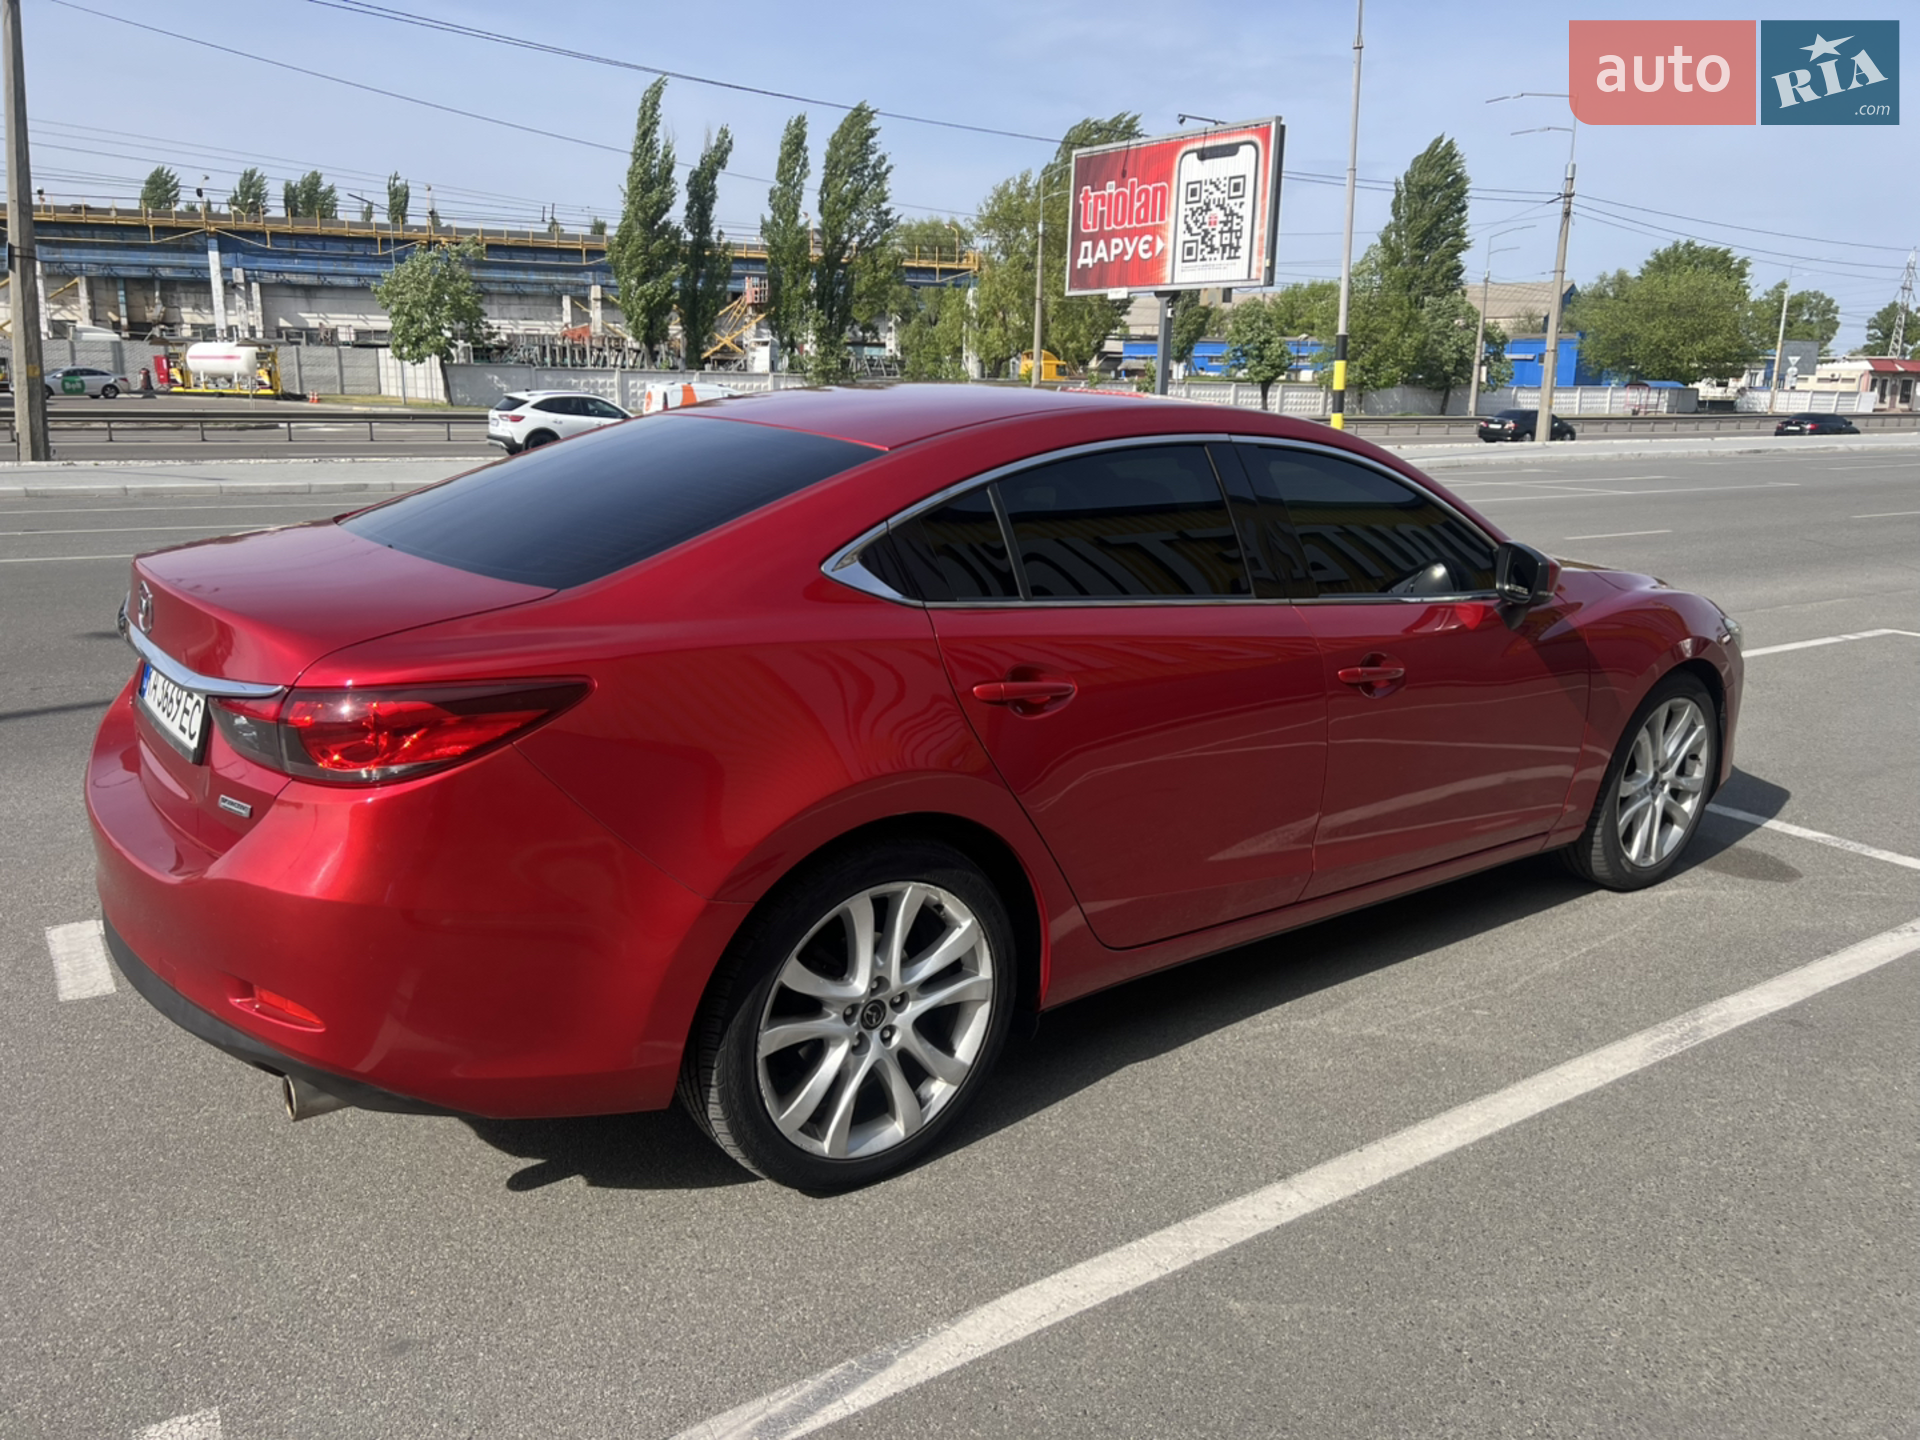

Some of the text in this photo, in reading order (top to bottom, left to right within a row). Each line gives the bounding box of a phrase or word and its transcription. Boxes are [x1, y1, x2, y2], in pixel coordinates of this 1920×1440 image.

[1079, 177, 1169, 233] triolan
[1077, 234, 1154, 269] ДАРУЄ
[178, 691, 202, 741] EC
